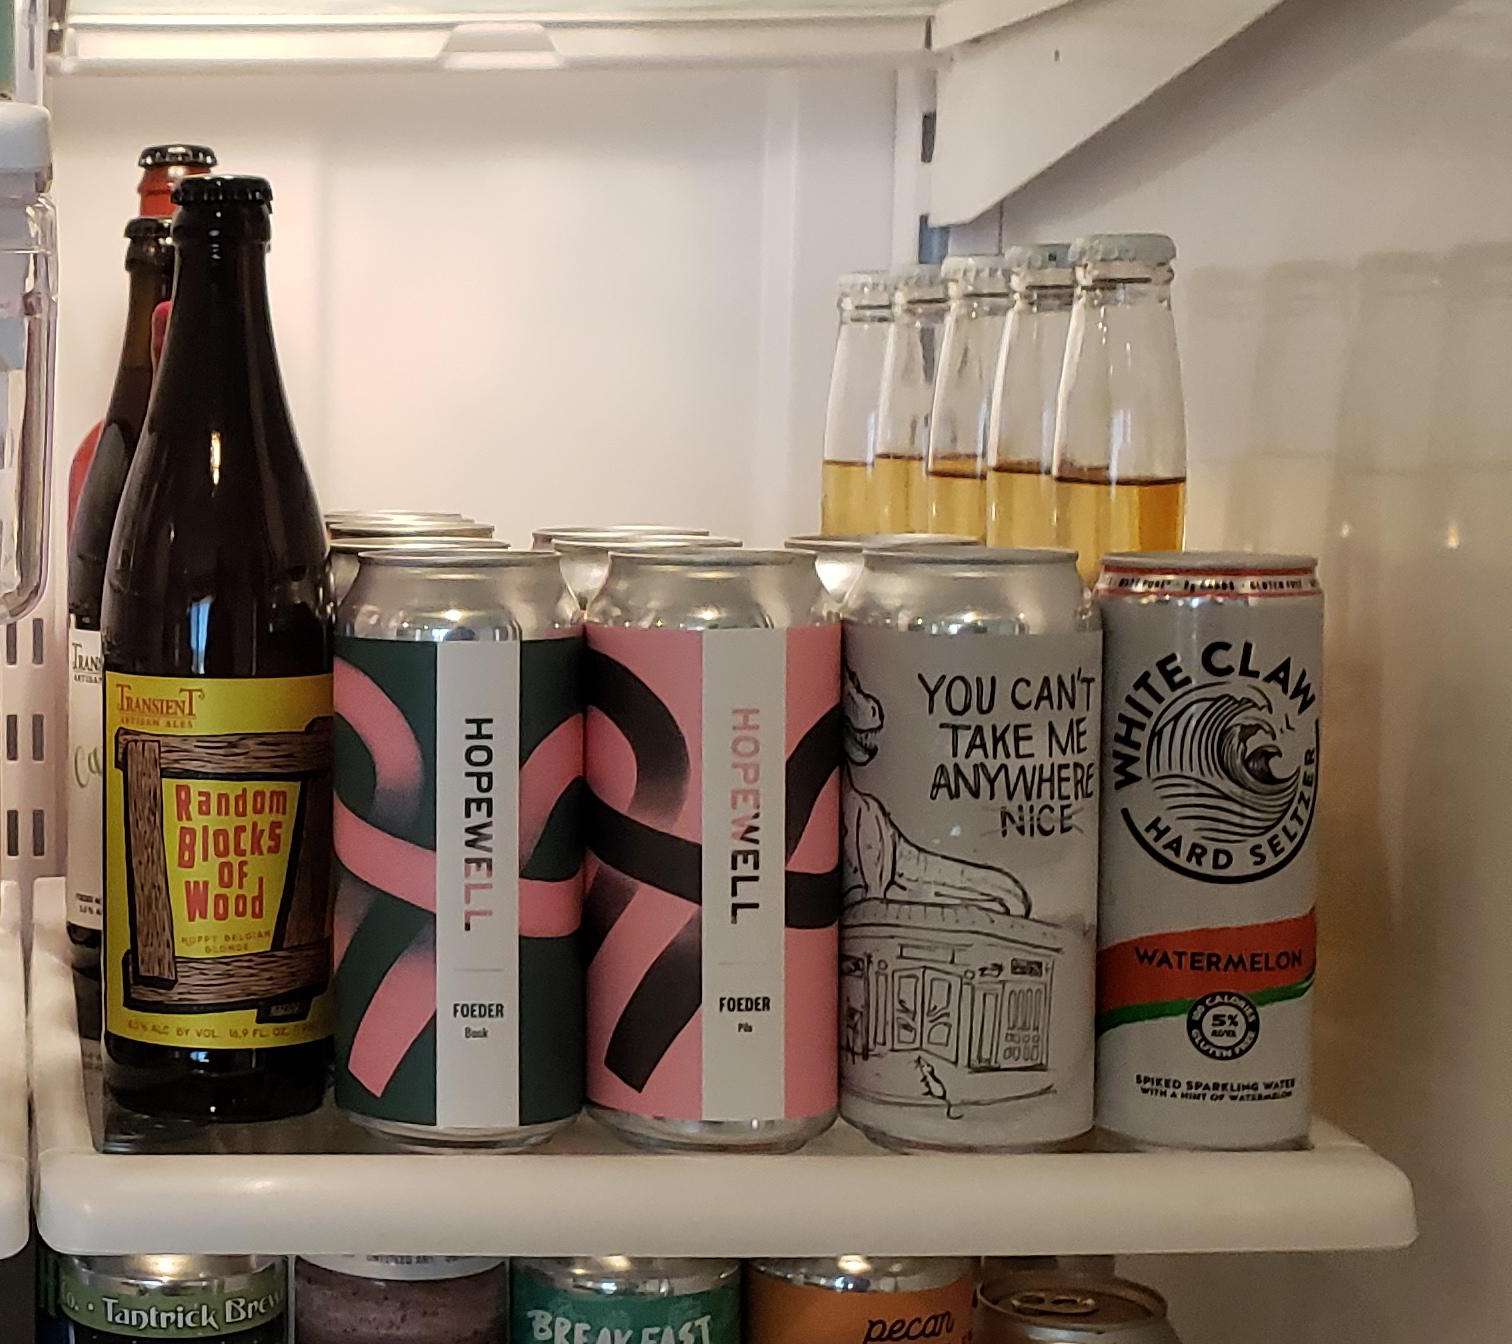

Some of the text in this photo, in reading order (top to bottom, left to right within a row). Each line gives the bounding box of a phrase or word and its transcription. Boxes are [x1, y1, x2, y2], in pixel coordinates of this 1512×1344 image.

[116, 683, 205, 717] TRANSIENT
[918, 667, 1096, 716] YOU CAN'T
[1113, 640, 1316, 790] WHITE CLAW
[939, 717, 1088, 760] TAKE ME
[929, 762, 1095, 803] ANYWHERE
[463, 717, 494, 933] HOPEWELL
[730, 707, 761, 926] HOPEWELL
[1144, 747, 1316, 870] HARD SELTZER
[1134, 946, 1303, 973] WATERMELON
[453, 1002, 505, 1020] FOEDER
[719, 996, 771, 1014] FOEDER
[1211, 1013, 1239, 1027] 5%
[1135, 1074, 1296, 1093] SPIKED SPARKLING WATER
[1140, 1087, 1168, 1098] WITH
[102, 1297, 220, 1330] Tantrick
